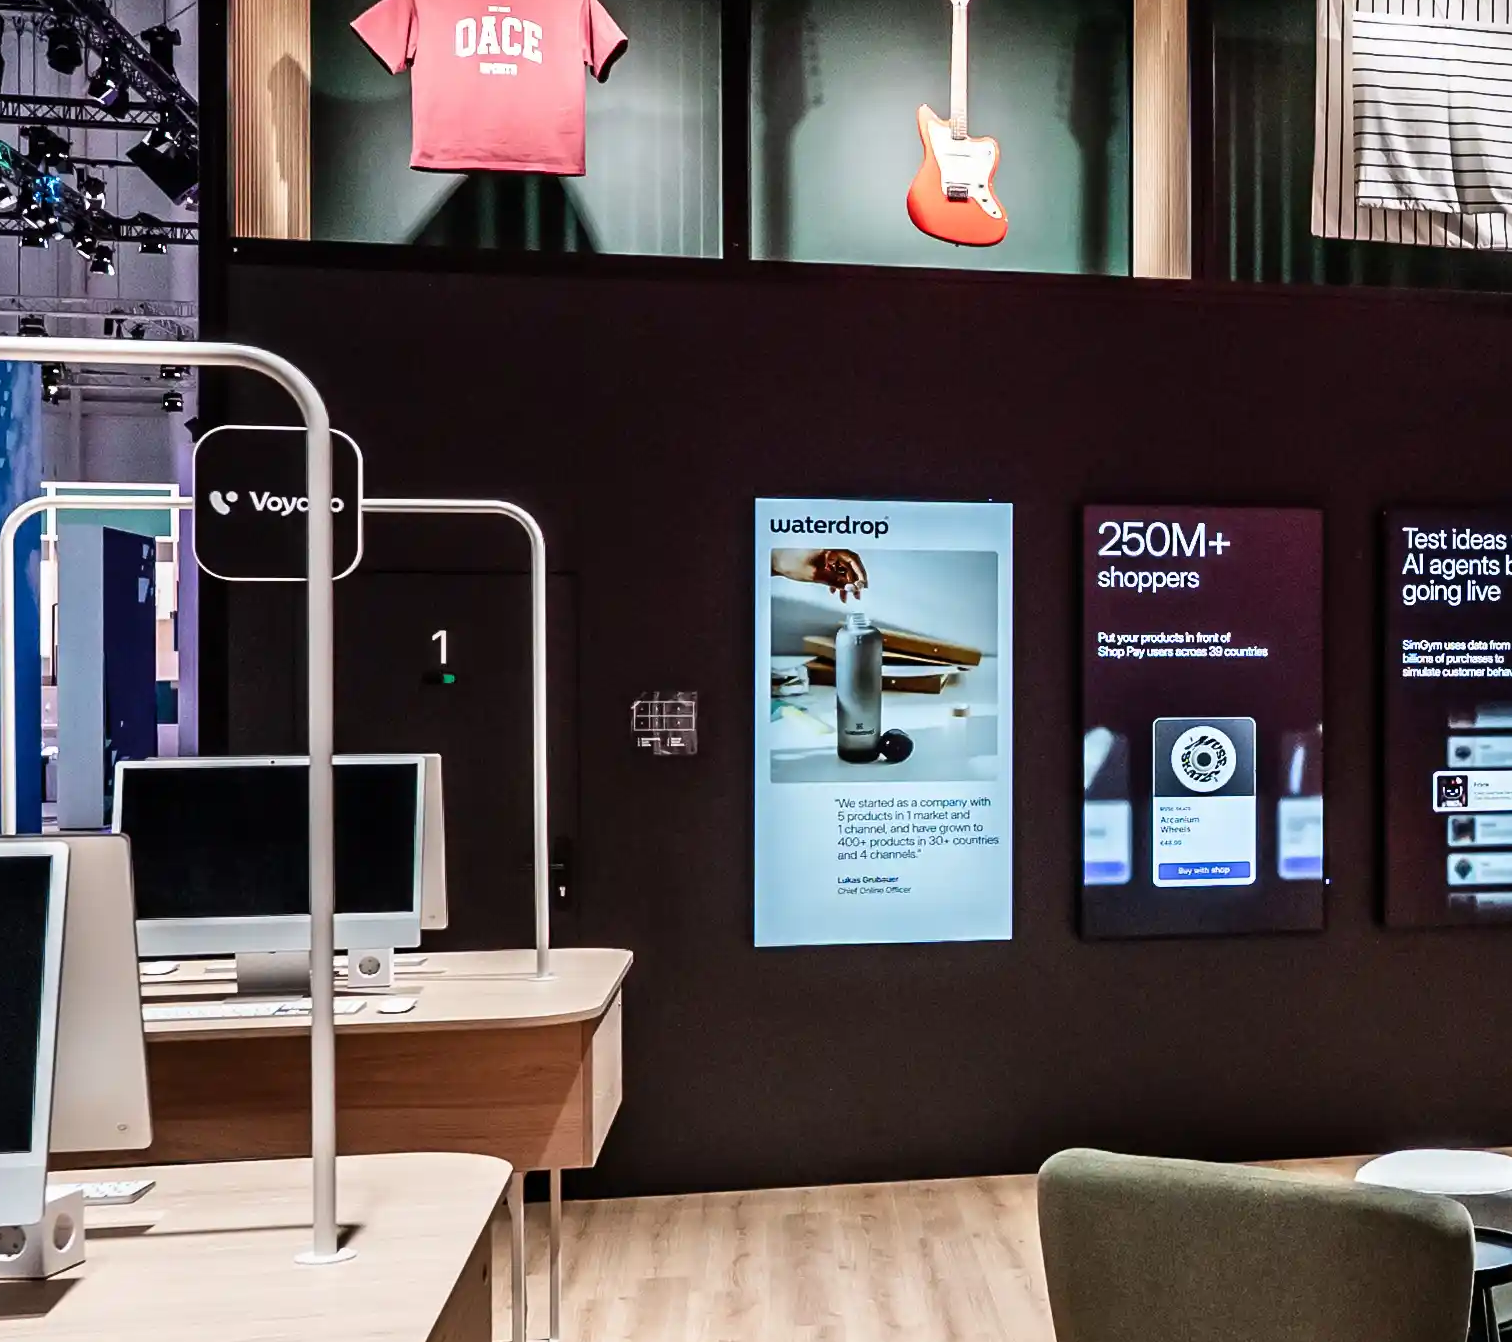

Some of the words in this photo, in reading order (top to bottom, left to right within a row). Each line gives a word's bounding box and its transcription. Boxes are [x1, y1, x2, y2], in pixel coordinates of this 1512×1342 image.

[249, 491, 345, 516] Voyao
[1098, 521, 1230, 558] 250M+
[1403, 528, 1446, 550] Test
[1452, 529, 1506, 550] ideas
[1403, 554, 1424, 575] AI
[1429, 554, 1500, 580] agents
[1098, 566, 1200, 593] shoppers
[1403, 581, 1462, 606] going
[1467, 580, 1502, 602] live
[1098, 632, 1116, 643] Put
[1117, 634, 1139, 645] your
[1141, 632, 1184, 645] products
[1185, 632, 1194, 643] in
[1196, 632, 1219, 643] front
[1220, 632, 1231, 643] of
[431, 629, 448, 665] 1
[1402, 640, 1442, 652] SimGym
[1444, 642, 1466, 650] uses
[1467, 640, 1488, 650] data
[1489, 640, 1511, 650] from
[1098, 646, 1125, 658] Shop
[1127, 646, 1145, 659] Pay
[1147, 647, 1173, 657] users
[1175, 647, 1207, 657] across
[1209, 646, 1222, 657] 39
[1224, 646, 1268, 657] countries
[1435, 653, 1444, 663] of
[1446, 655, 1493, 665] purchases
[1495, 654, 1504, 663] to
[1402, 667, 1441, 677] simulate
[1442, 668, 1485, 677] customer
[858, 798, 894, 808] started
[920, 799, 967, 809] company
[970, 797, 991, 806] with
[838, 813, 844, 821] 5
[847, 811, 892, 822] products
[895, 811, 904, 820] in
[907, 811, 911, 820] 1
[914, 811, 948, 820] market
[951, 811, 970, 819] and
[838, 825, 842, 833] 1
[891, 824, 909, 833] and
[912, 824, 936, 832] have
[939, 824, 970, 834] grown
[974, 824, 983, 832] to
[838, 837, 866, 847] 400+
[870, 837, 915, 848] products
[918, 837, 926, 845] in
[953, 836, 999, 845] countries
[838, 851, 857, 860] and
[860, 850, 868, 859] 4
[1178, 867, 1192, 876] Buy
[1211, 866, 1230, 875] shop
